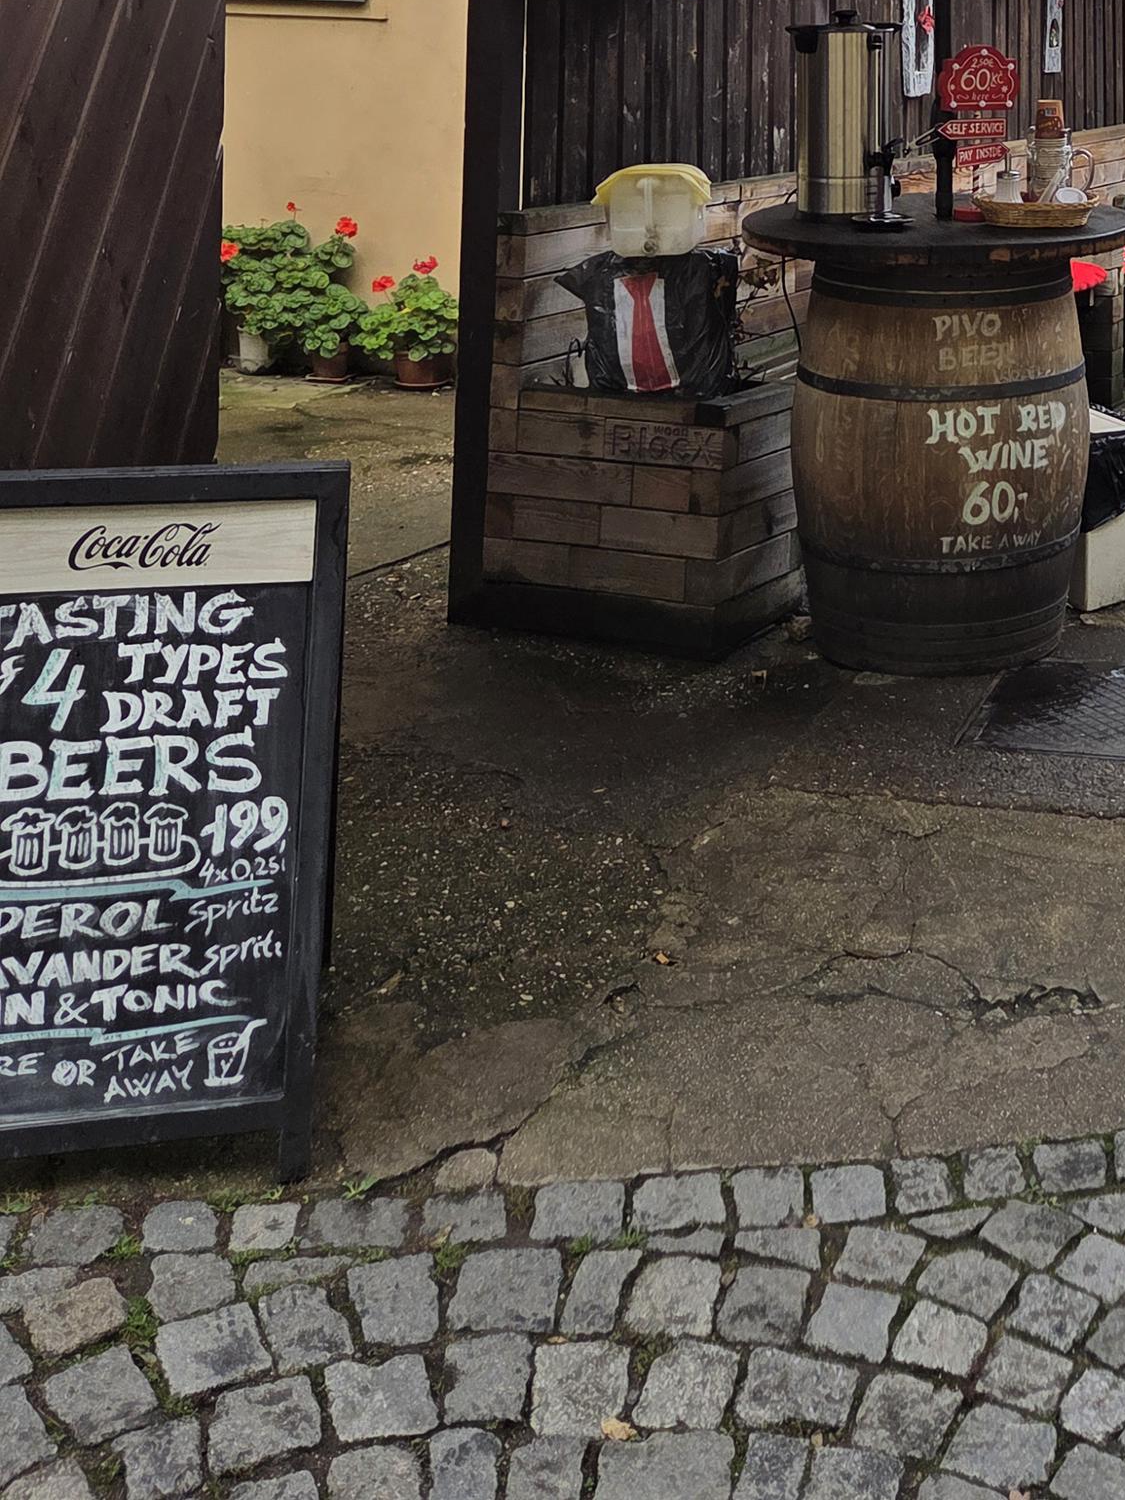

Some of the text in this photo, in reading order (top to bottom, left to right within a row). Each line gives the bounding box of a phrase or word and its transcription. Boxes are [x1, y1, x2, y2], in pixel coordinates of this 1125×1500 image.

[946, 121, 1004, 135] SELF SERVICE
[960, 145, 1002, 161] PAY INSIDE
[932, 311, 1002, 341] PIVO
[925, 401, 1067, 445] HOT RED
[958, 435, 1053, 474] WINE
[68, 522, 223, 571] Coca-Cola
[940, 533, 992, 554] TAKE
[21, 648, 86, 732] 4
[118, 637, 288, 685] TYPES
[100, 685, 281, 733] DRAFT
[0, 725, 262, 802] BEERS
[53, 992, 90, 1026] &
[89, 980, 238, 1022] TONIC
[52, 1059, 97, 1087] OR
[101, 1029, 201, 1072] TAKE
[103, 1059, 195, 1104] AWAY
